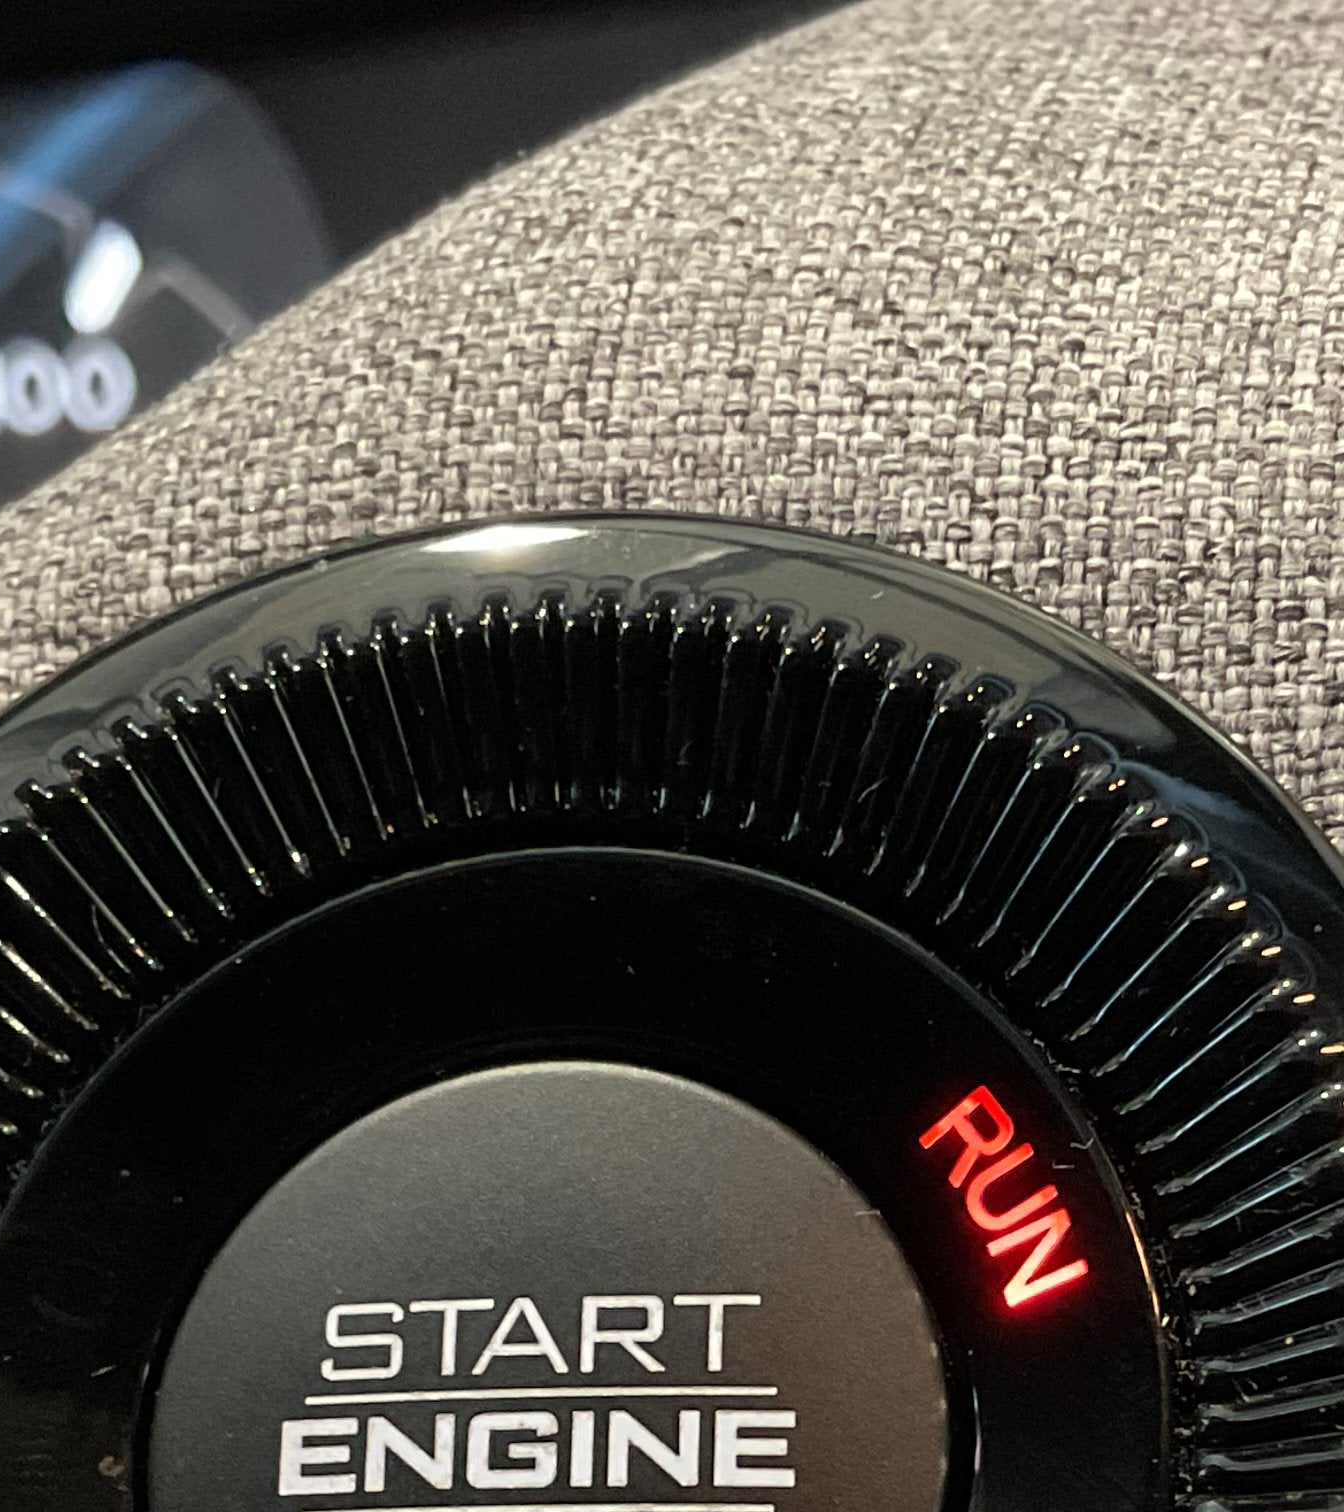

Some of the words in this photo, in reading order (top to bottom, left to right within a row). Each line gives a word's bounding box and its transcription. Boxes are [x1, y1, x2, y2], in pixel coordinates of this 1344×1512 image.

[918, 1085, 1089, 1308] RUN
[320, 1293, 762, 1381] START
[278, 1409, 796, 1496] ENGINE
